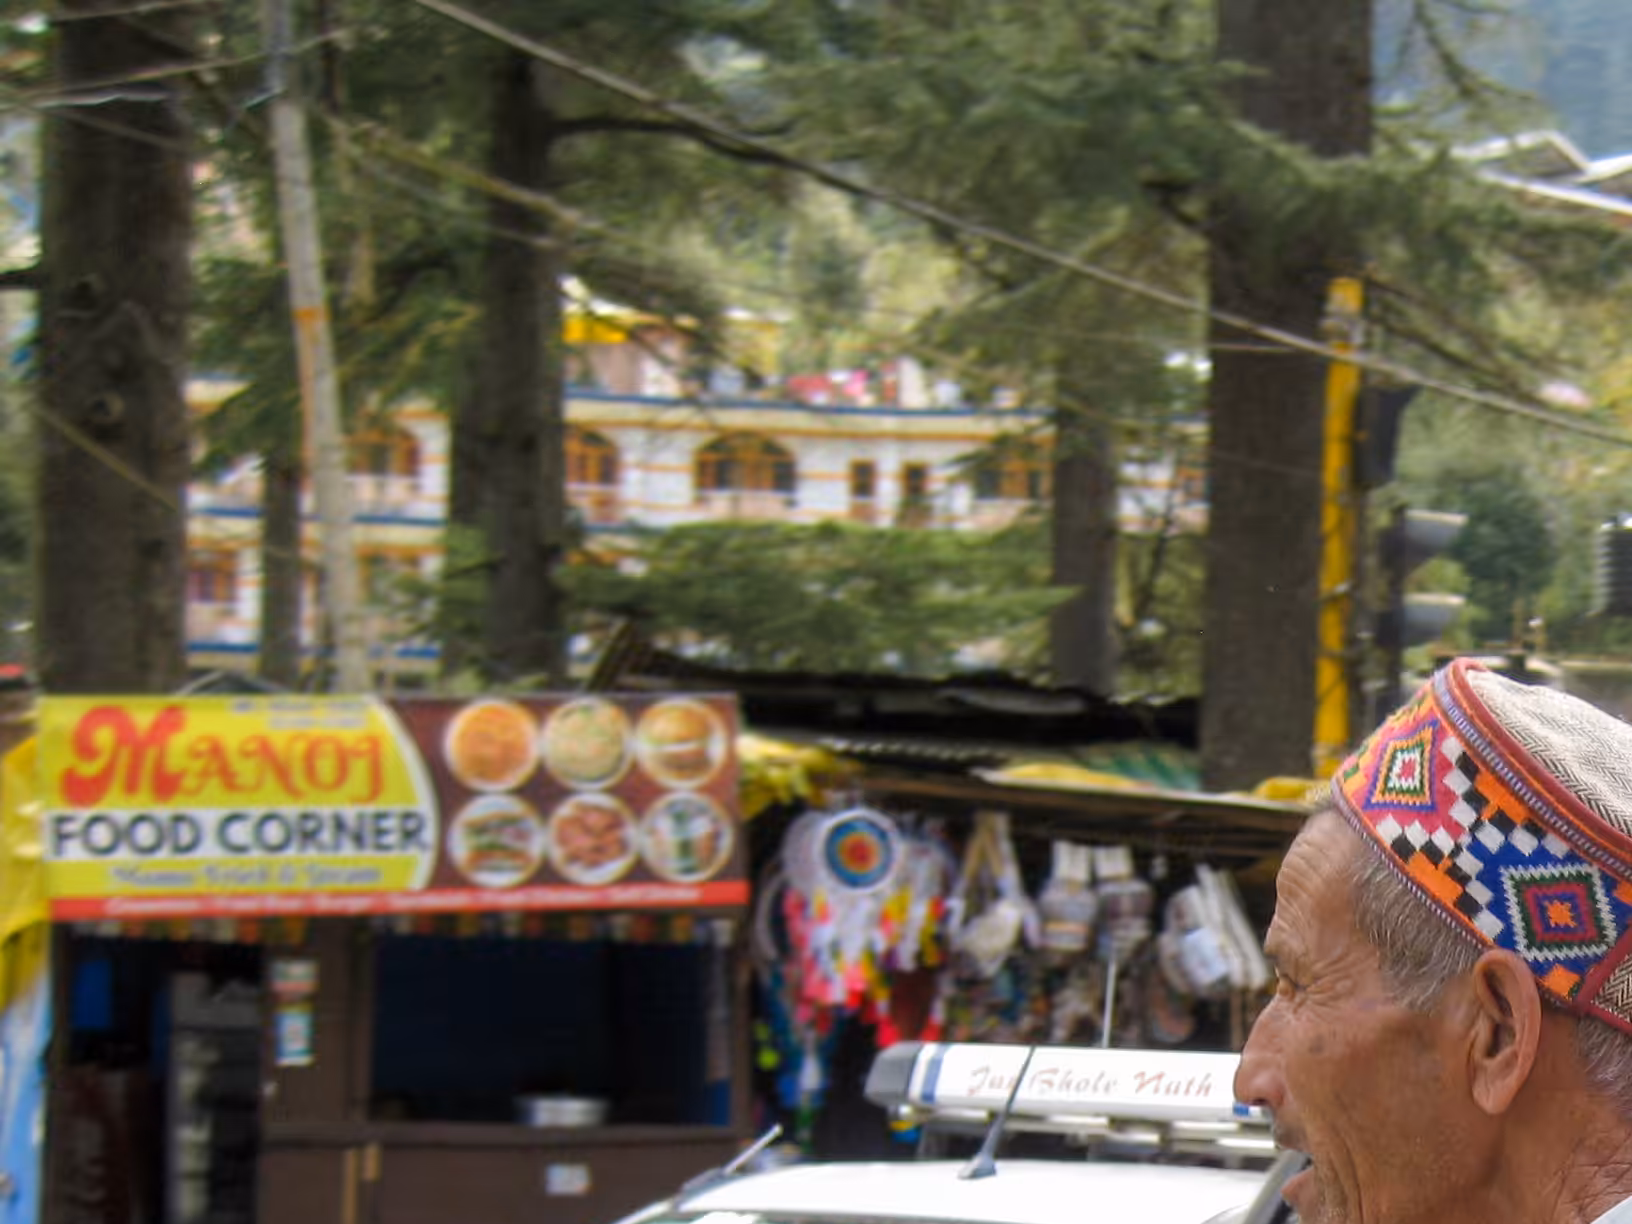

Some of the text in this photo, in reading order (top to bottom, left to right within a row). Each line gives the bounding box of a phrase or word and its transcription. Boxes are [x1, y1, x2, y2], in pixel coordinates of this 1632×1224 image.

[51, 810, 427, 857] FOOD CORNER
[1133, 1070, 1216, 1098] Nath
